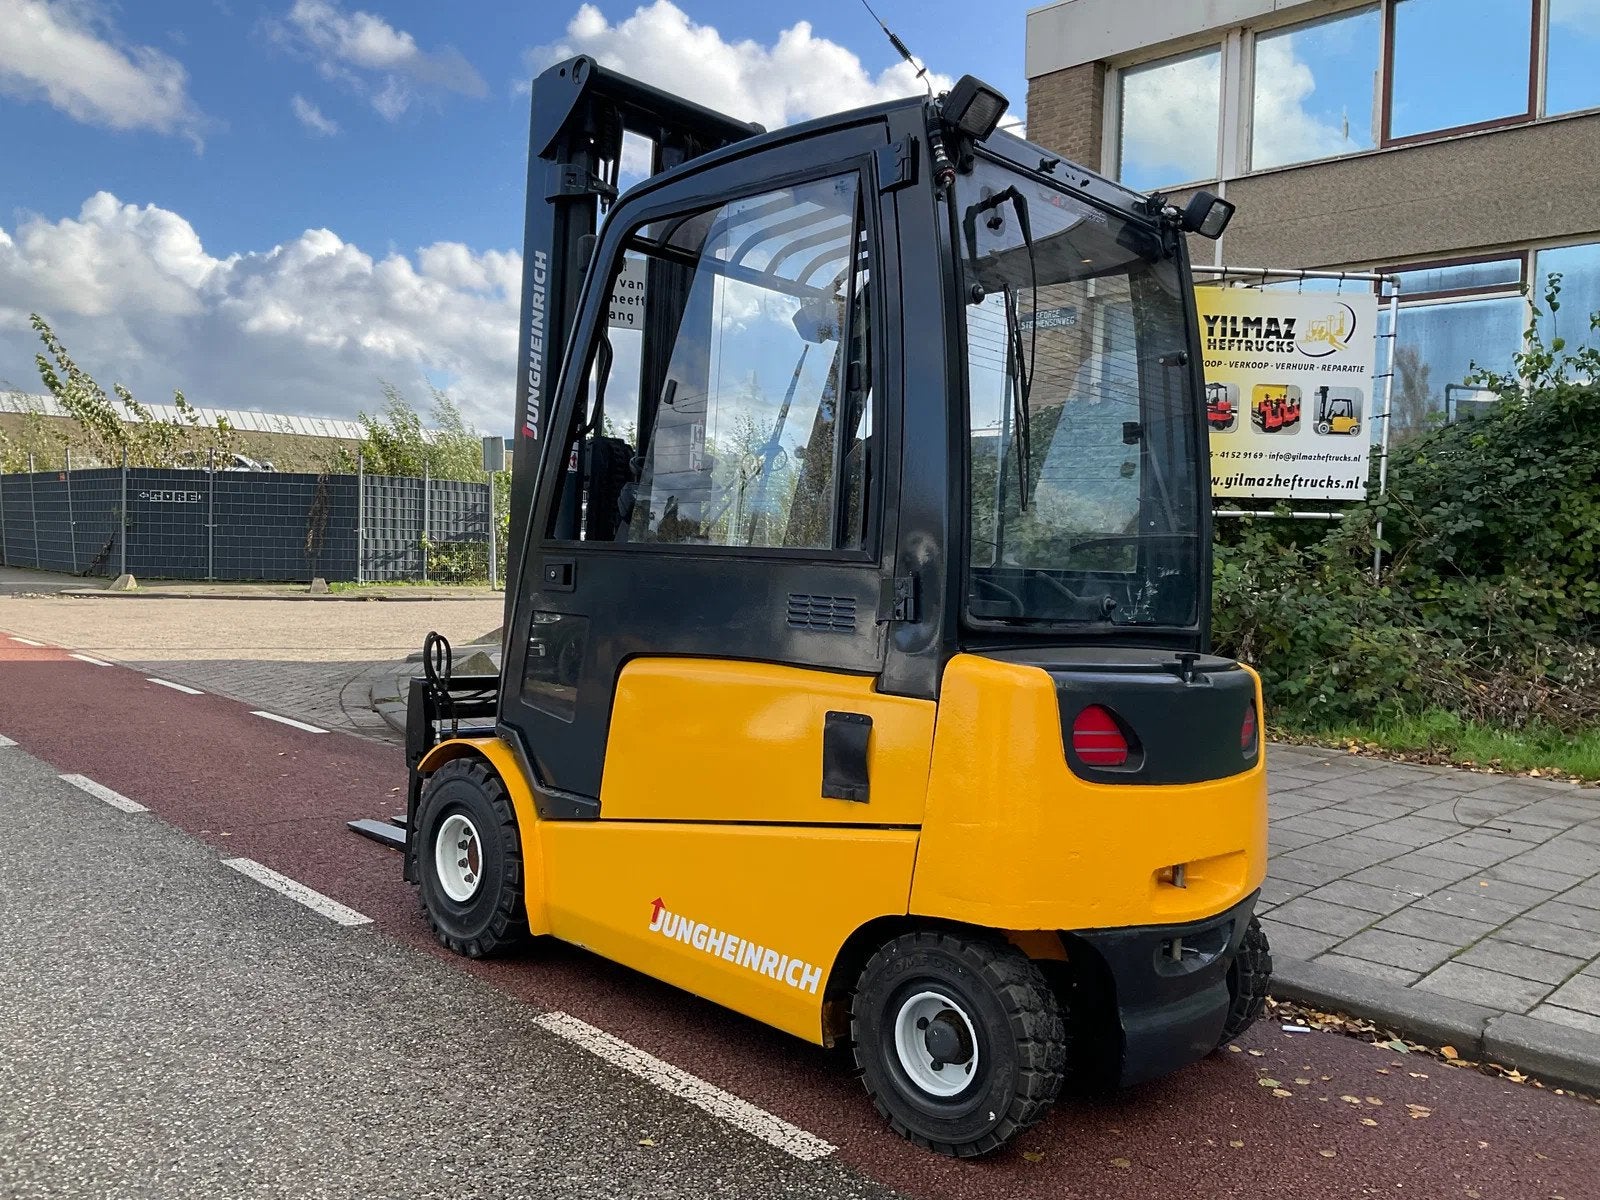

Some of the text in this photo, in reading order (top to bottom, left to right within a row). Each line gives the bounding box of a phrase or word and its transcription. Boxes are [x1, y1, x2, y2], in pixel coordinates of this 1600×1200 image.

[619, 279, 644, 290] van
[1021, 316, 1075, 330] STEHENSONWEG
[1203, 314, 1297, 339] YILMAZ
[524, 250, 547, 440] JUNGHEINRICH
[1207, 338, 1295, 353] HEFTRUCKS
[1203, 360, 1223, 368] OOP
[1229, 360, 1270, 370] VERKOOP
[1275, 362, 1316, 371] VERHUUR
[1320, 364, 1366, 373] REPARATIE
[1231, 451, 1241, 459] 52
[1243, 451, 1252, 459] 91
[1268, 452, 1361, 462] info@yilmazheftrucks.nl
[648, 906, 823, 994] JUNGHEINRICH
